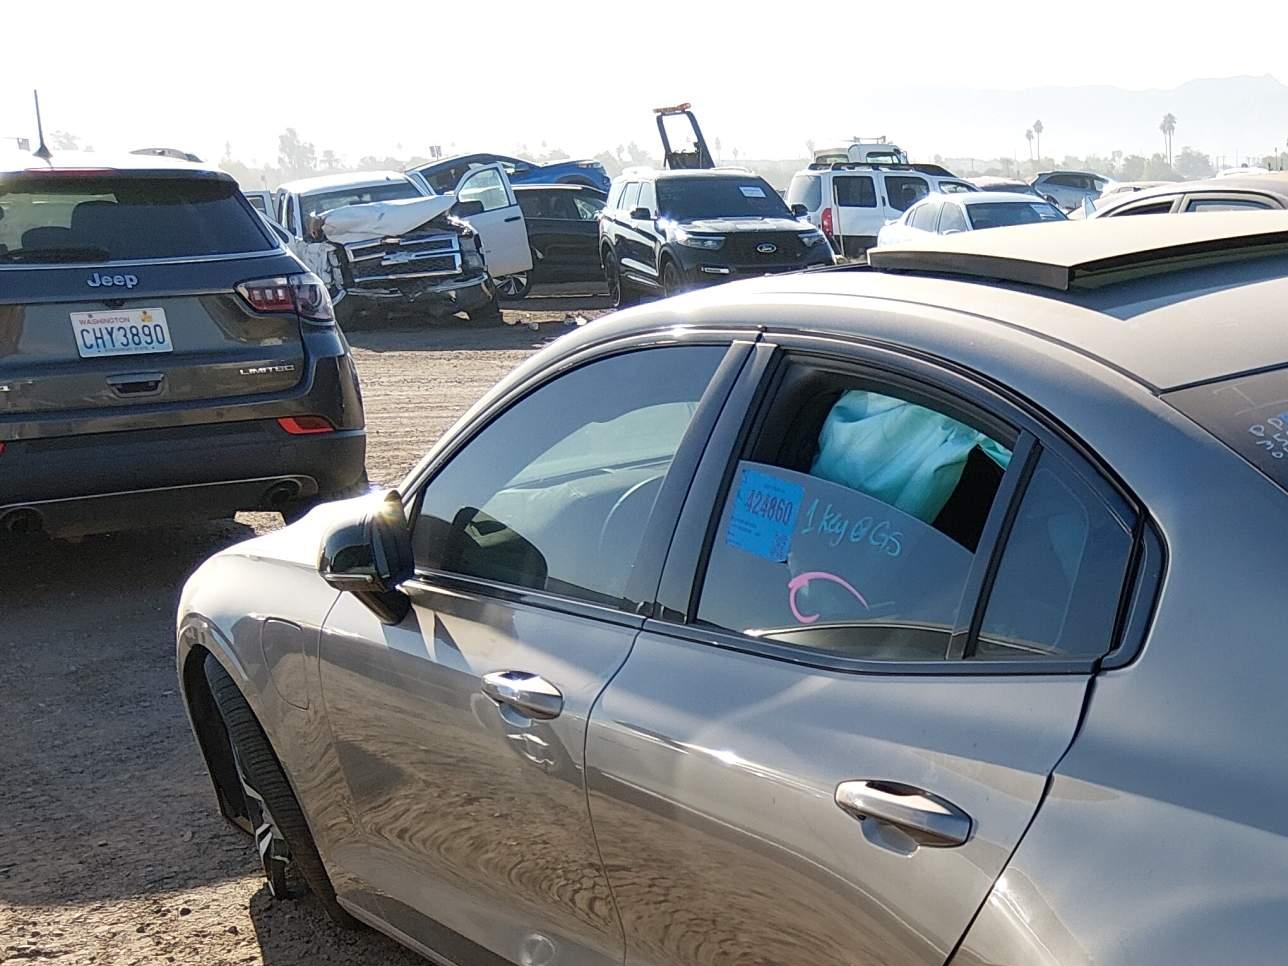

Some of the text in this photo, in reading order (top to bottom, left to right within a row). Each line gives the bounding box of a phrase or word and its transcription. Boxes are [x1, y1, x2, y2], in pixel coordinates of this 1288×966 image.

[87, 272, 138, 288] Jeep
[79, 316, 130, 325] WASHINGTON
[80, 323, 166, 350] CHY3890
